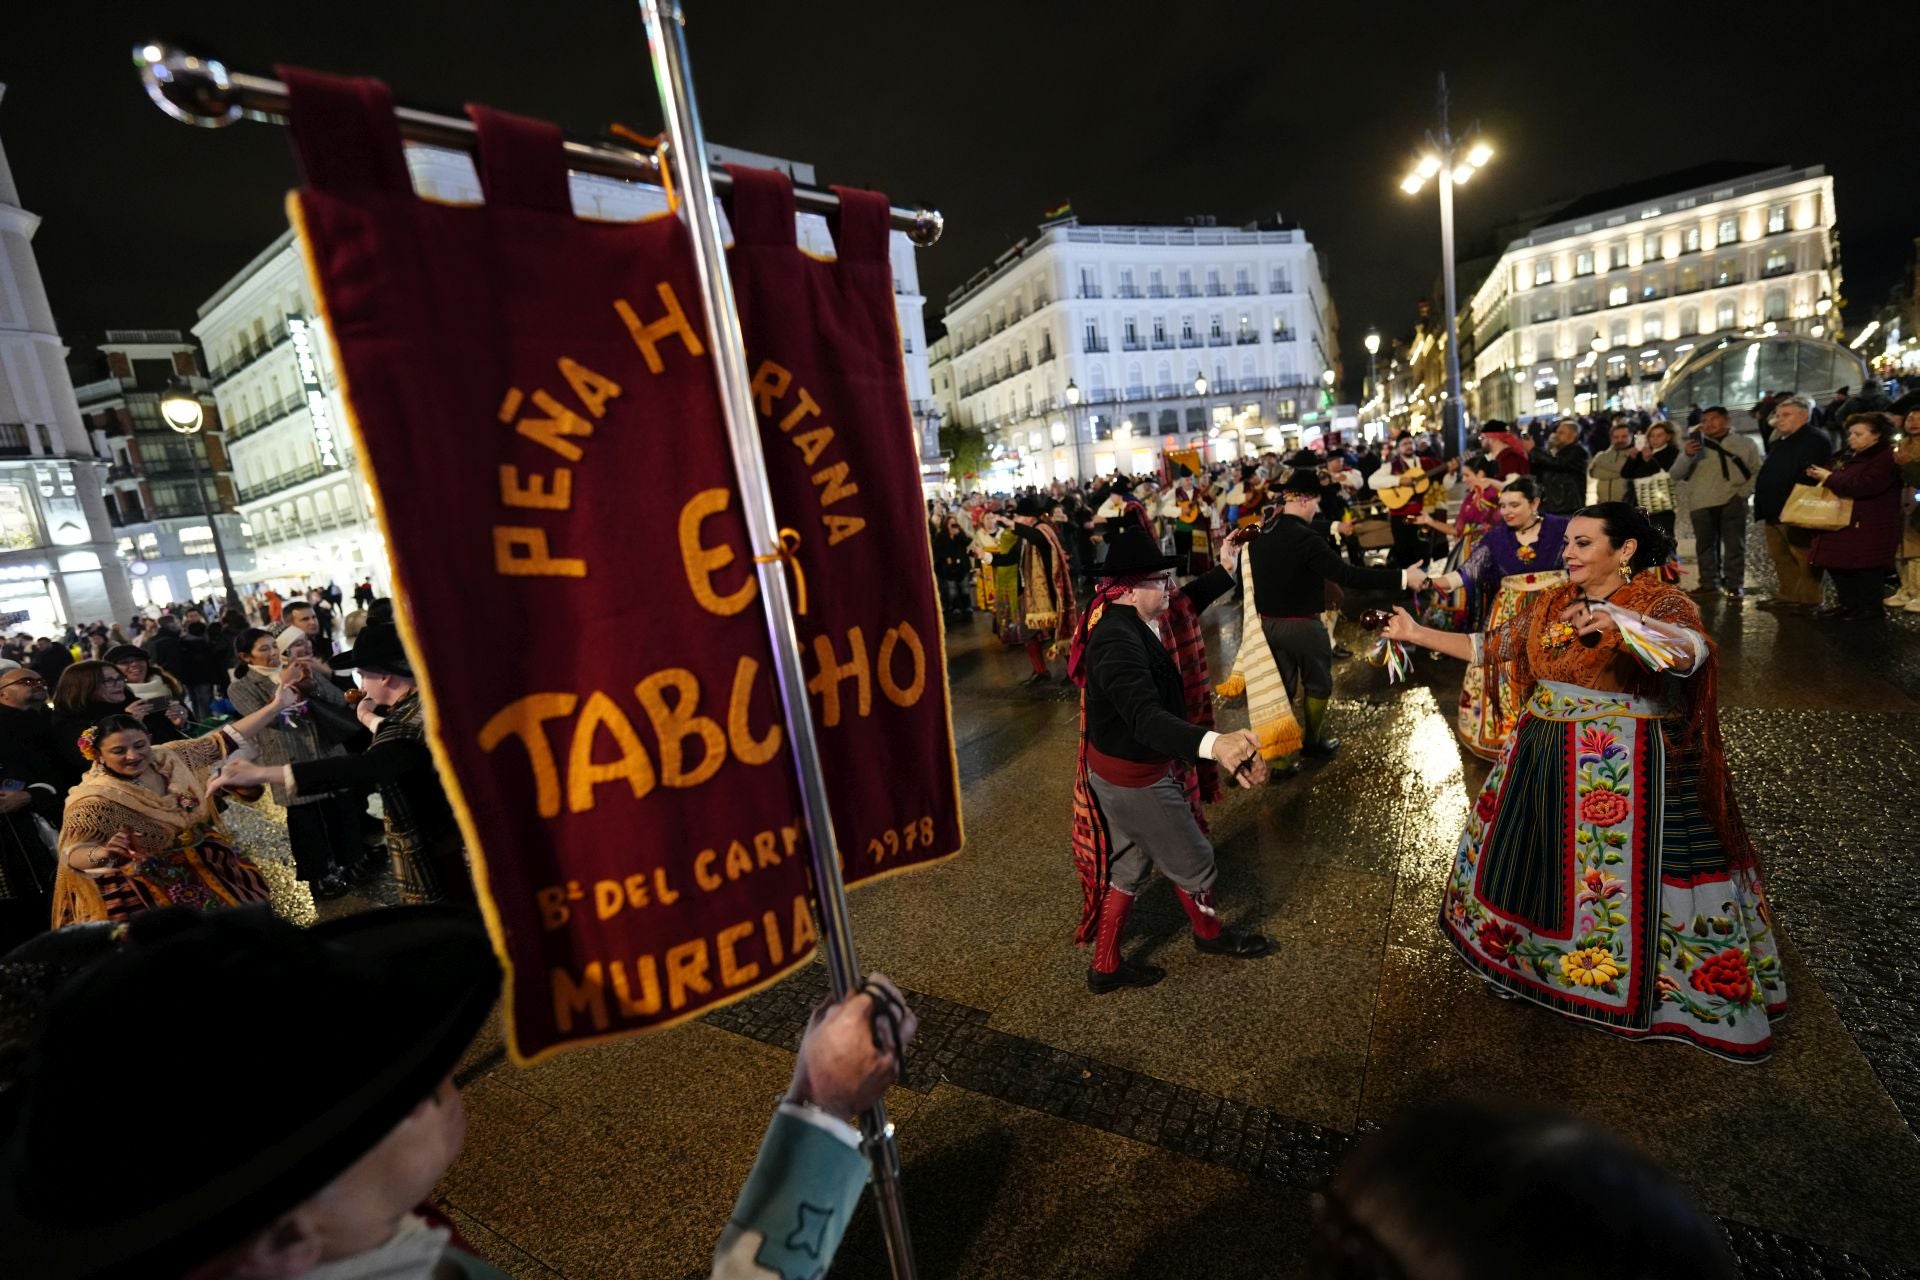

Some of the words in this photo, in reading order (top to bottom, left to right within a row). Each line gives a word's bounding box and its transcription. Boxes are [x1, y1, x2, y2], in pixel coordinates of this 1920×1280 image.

[492, 355, 622, 577] PEÑA
[613, 281, 866, 546] HRTANA
[678, 488, 758, 616] E
[478, 620, 926, 818] TABLHO
[594, 867, 680, 921] DEL
[867, 815, 935, 864] 1978
[553, 895, 817, 1035] MURCIA
